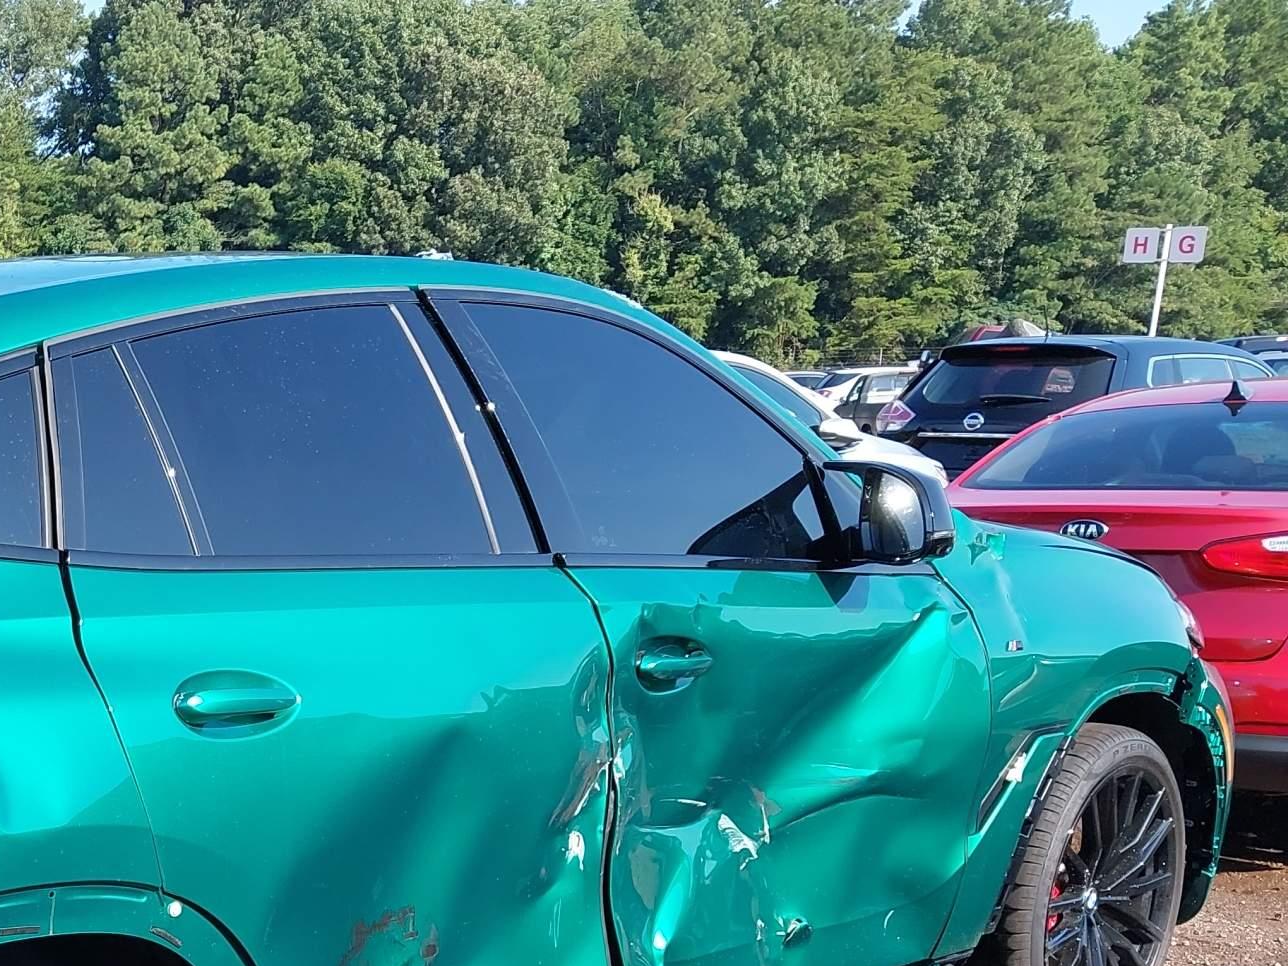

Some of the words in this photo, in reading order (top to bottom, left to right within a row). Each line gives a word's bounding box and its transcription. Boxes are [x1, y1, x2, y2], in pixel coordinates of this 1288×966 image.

[1133, 237, 1148, 254] H
[1179, 236, 1196, 253] G
[1067, 524, 1098, 537] KIA
